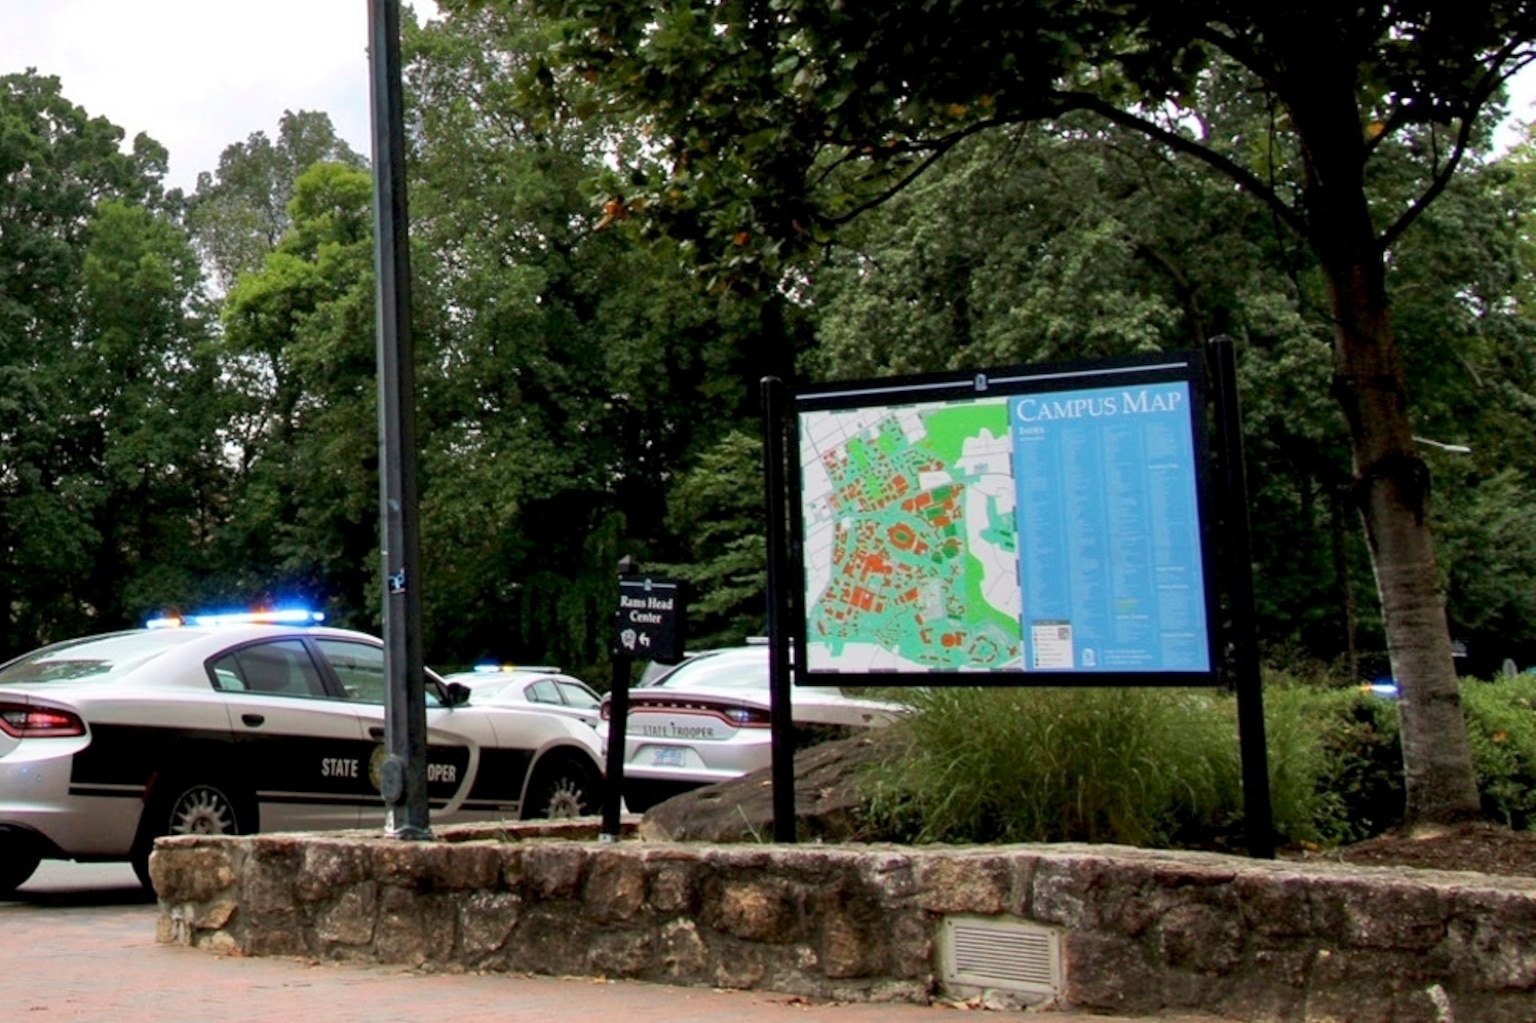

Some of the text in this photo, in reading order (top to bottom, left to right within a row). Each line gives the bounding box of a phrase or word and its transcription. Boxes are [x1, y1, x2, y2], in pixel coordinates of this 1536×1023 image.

[620, 595, 674, 610] Rams Head
[629, 610, 662, 624] Center
[643, 725, 667, 736] STATE
[672, 726, 714, 737] TROOPER
[321, 758, 456, 783] STATE OPER
